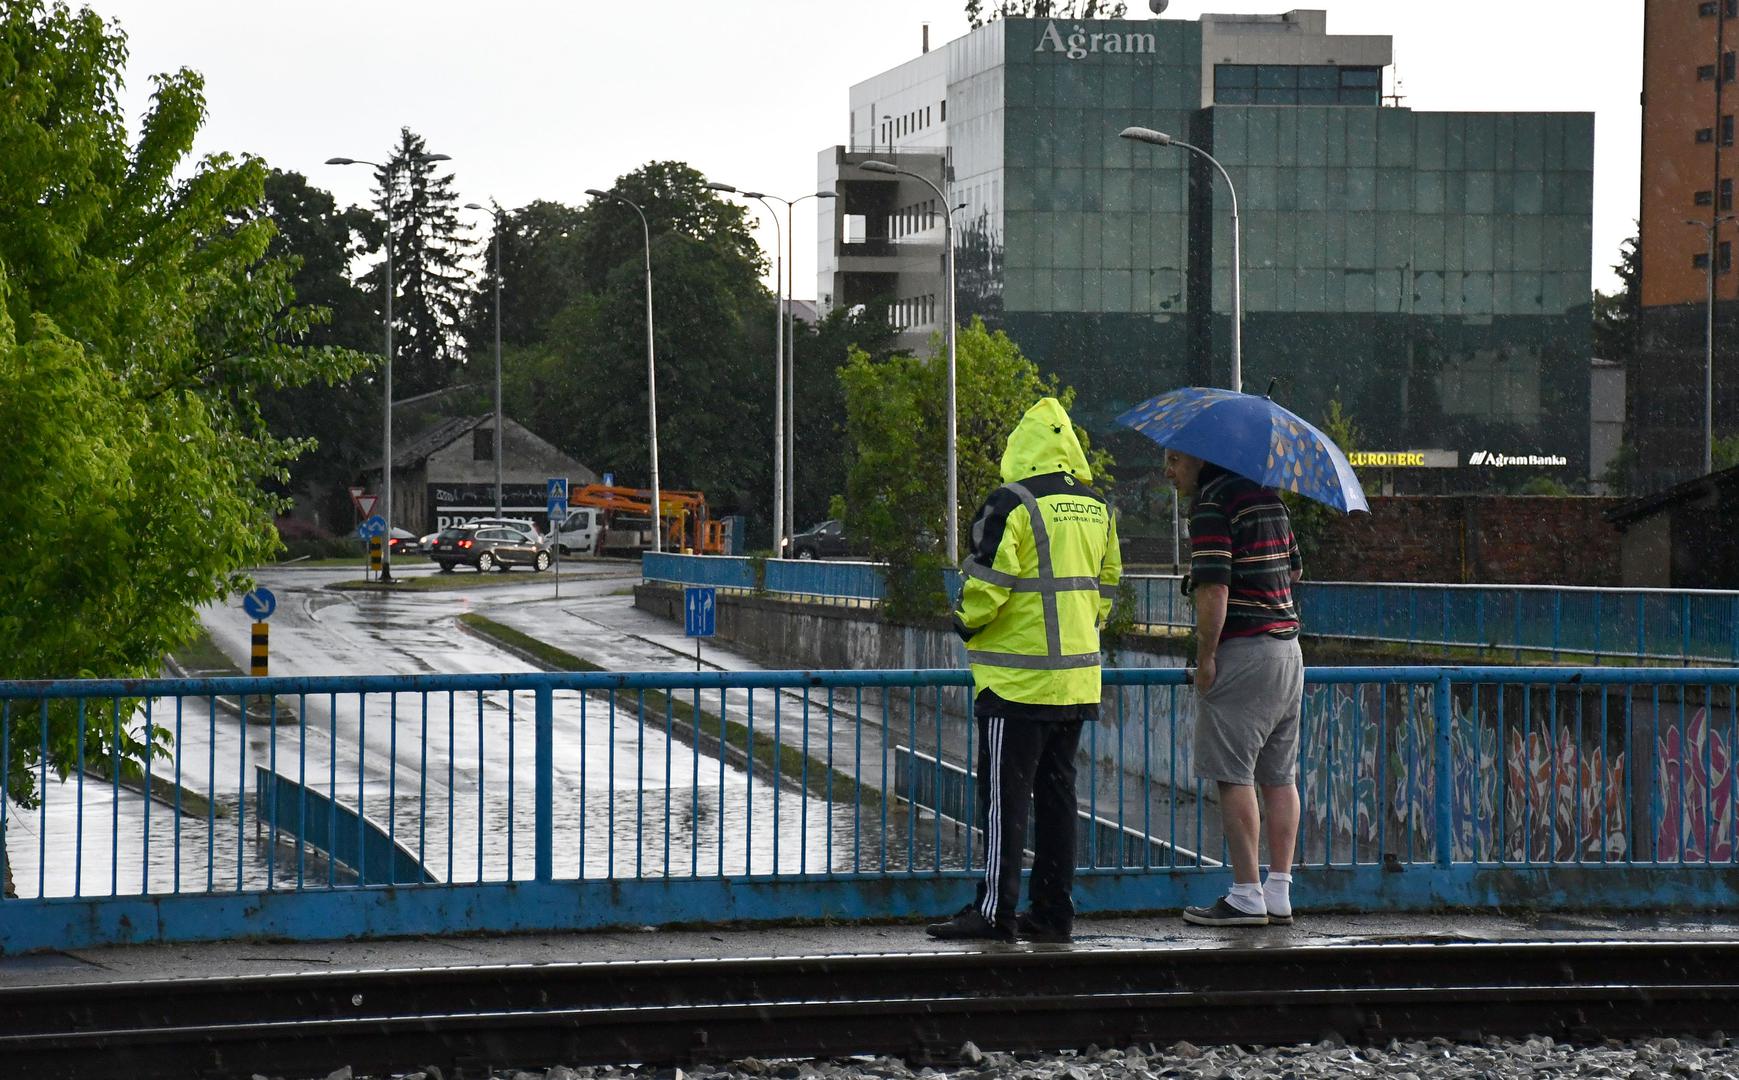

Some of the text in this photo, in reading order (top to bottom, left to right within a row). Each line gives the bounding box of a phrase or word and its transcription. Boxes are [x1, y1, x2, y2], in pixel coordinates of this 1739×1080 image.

[1034, 19, 1156, 60] Agram
[1349, 452, 1425, 466] EUROHERC
[1485, 452, 1567, 468] Agram Banka
